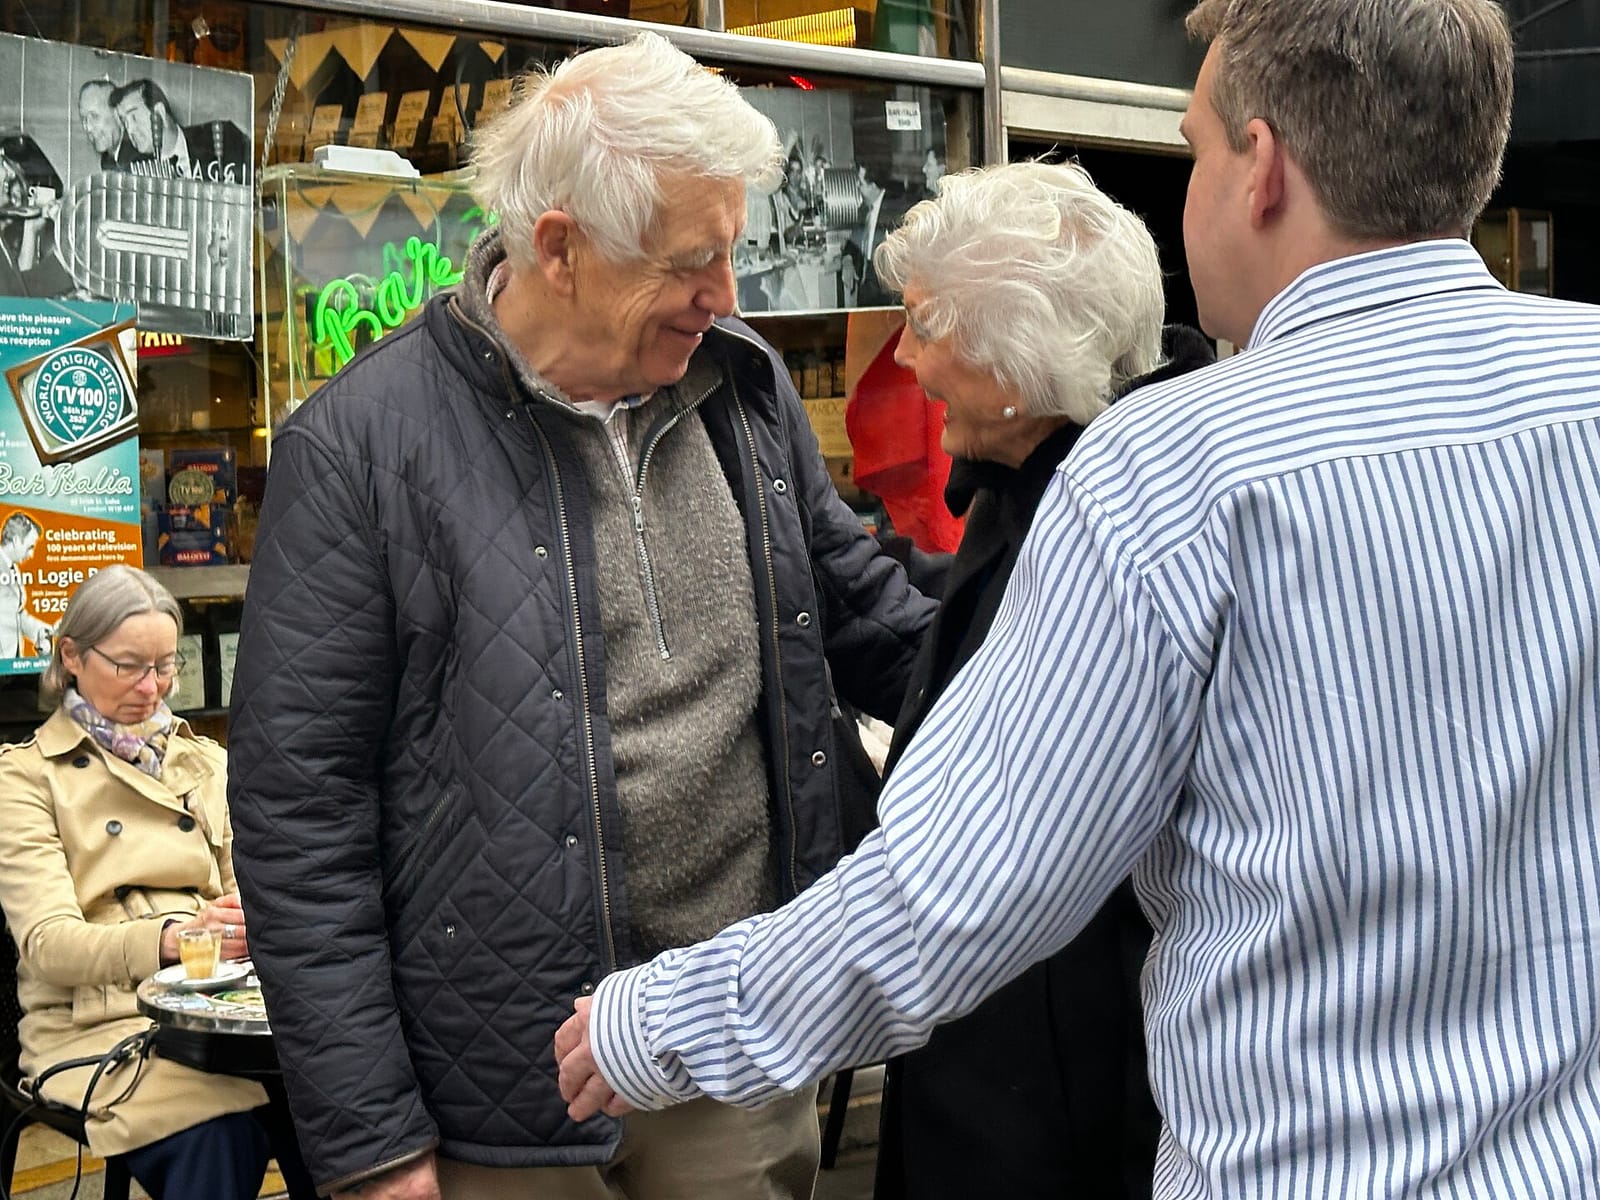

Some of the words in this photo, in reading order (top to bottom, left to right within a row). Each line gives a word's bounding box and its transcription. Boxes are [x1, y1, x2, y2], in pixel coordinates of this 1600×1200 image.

[0, 313, 16, 322] ave
[18, 313, 33, 322] the
[34, 313, 71, 325] pleasure
[25, 326, 41, 335] you
[43, 327, 53, 335] to
[10, 336, 51, 348] reception
[39, 372, 55, 425] WORLD
[51, 353, 99, 372] ORIGIN
[0, 462, 45, 496] Bar
[46, 462, 133, 497] Italia
[45, 528, 116, 543] Celebrating
[46, 544, 62, 553] 100
[63, 544, 86, 554] years
[86, 542, 97, 553] of
[97, 541, 137, 552] television
[38, 567, 84, 588] Logie
[31, 597, 69, 613] 1926
